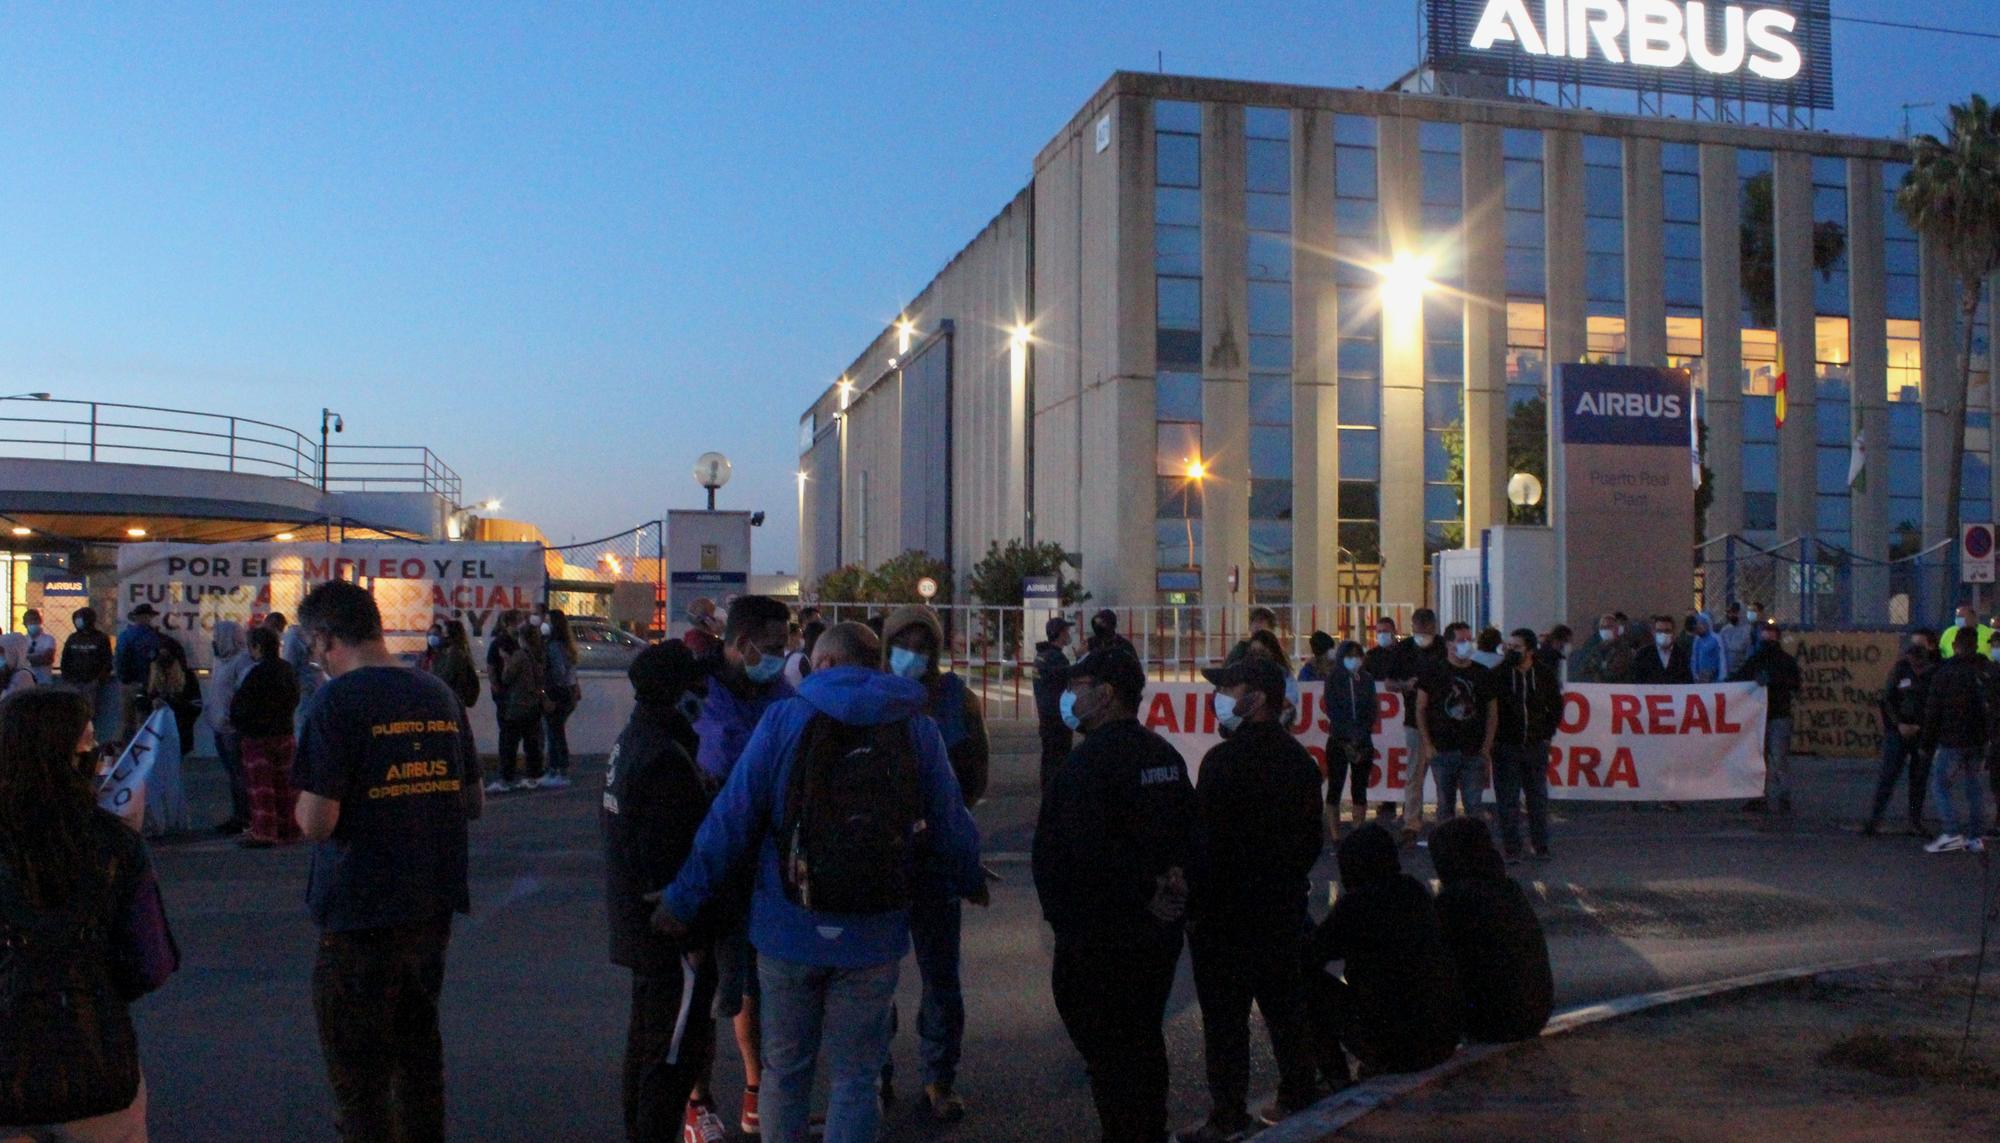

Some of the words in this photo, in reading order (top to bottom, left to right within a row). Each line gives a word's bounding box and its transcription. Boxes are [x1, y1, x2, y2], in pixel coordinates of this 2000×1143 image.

[1470, 0, 1801, 80] AIRBUS
[1575, 392, 1682, 419] AIRBUS
[1590, 471, 1637, 486] Puerto
[1640, 471, 1670, 487] Real
[168, 557, 231, 577] POR
[434, 559, 452, 579] Y
[462, 560, 494, 579] EL
[46, 582, 82, 591] AIRBUS
[1026, 583, 1056, 592] AIRBUS
[1610, 692, 1742, 735] REAL
[371, 721, 425, 738] PUERTO
[427, 720, 460, 734] REAL
[386, 760, 448, 781] AIRBUS
[1140, 766, 1180, 785] AIRBUS
